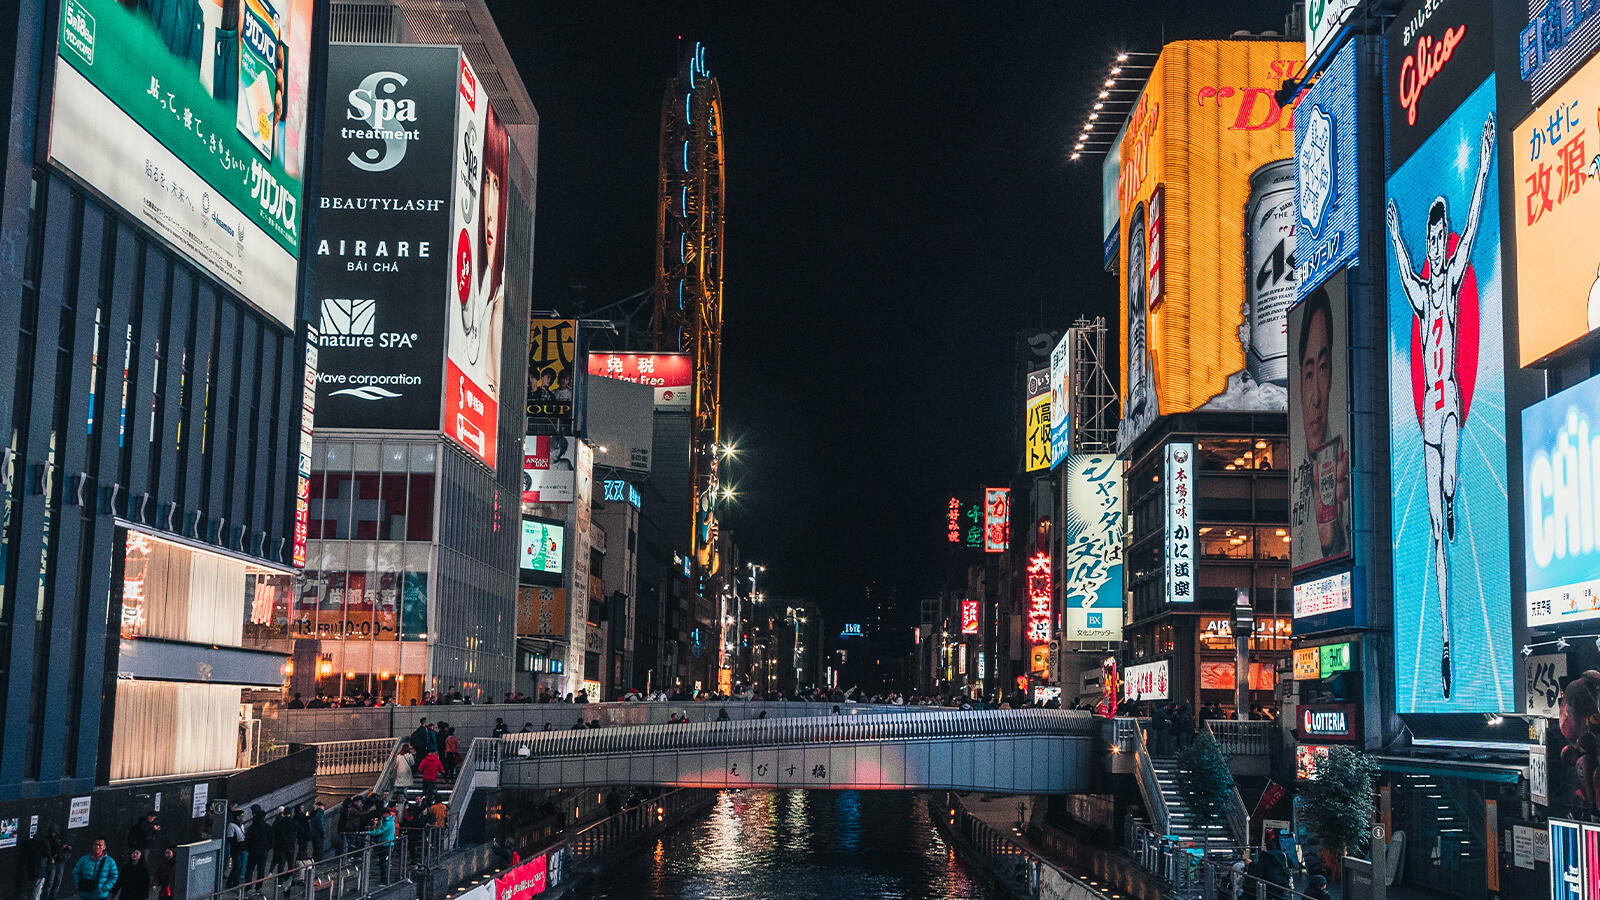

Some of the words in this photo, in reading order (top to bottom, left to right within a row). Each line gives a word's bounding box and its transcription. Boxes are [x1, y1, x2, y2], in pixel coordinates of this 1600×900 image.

[1400, 24, 1466, 126] Glico
[347, 89, 417, 129] Spa
[341, 127, 420, 140] treatment
[1530, 100, 1580, 162] かぜに
[1525, 127, 1588, 227] 改源
[251, 158, 297, 237] サロンパス
[317, 240, 430, 257] AIRARE
[347, 261, 367, 271] BÁI
[373, 261, 399, 272] CHÁ
[320, 334, 374, 347] nature
[607, 357, 655, 374] 免税
[1431, 309, 1446, 411] グリコ
[348, 372, 421, 386] corporation
[640, 375, 665, 385] Free
[1028, 407, 1042, 468] バイト
[1174, 468, 1188, 519] 本場の味
[1174, 525, 1190, 597] かに道楽
[1089, 615, 1101, 625] BX
[1312, 712, 1346, 731] LOTTERIA
[730, 762, 827, 779] えびす橋
